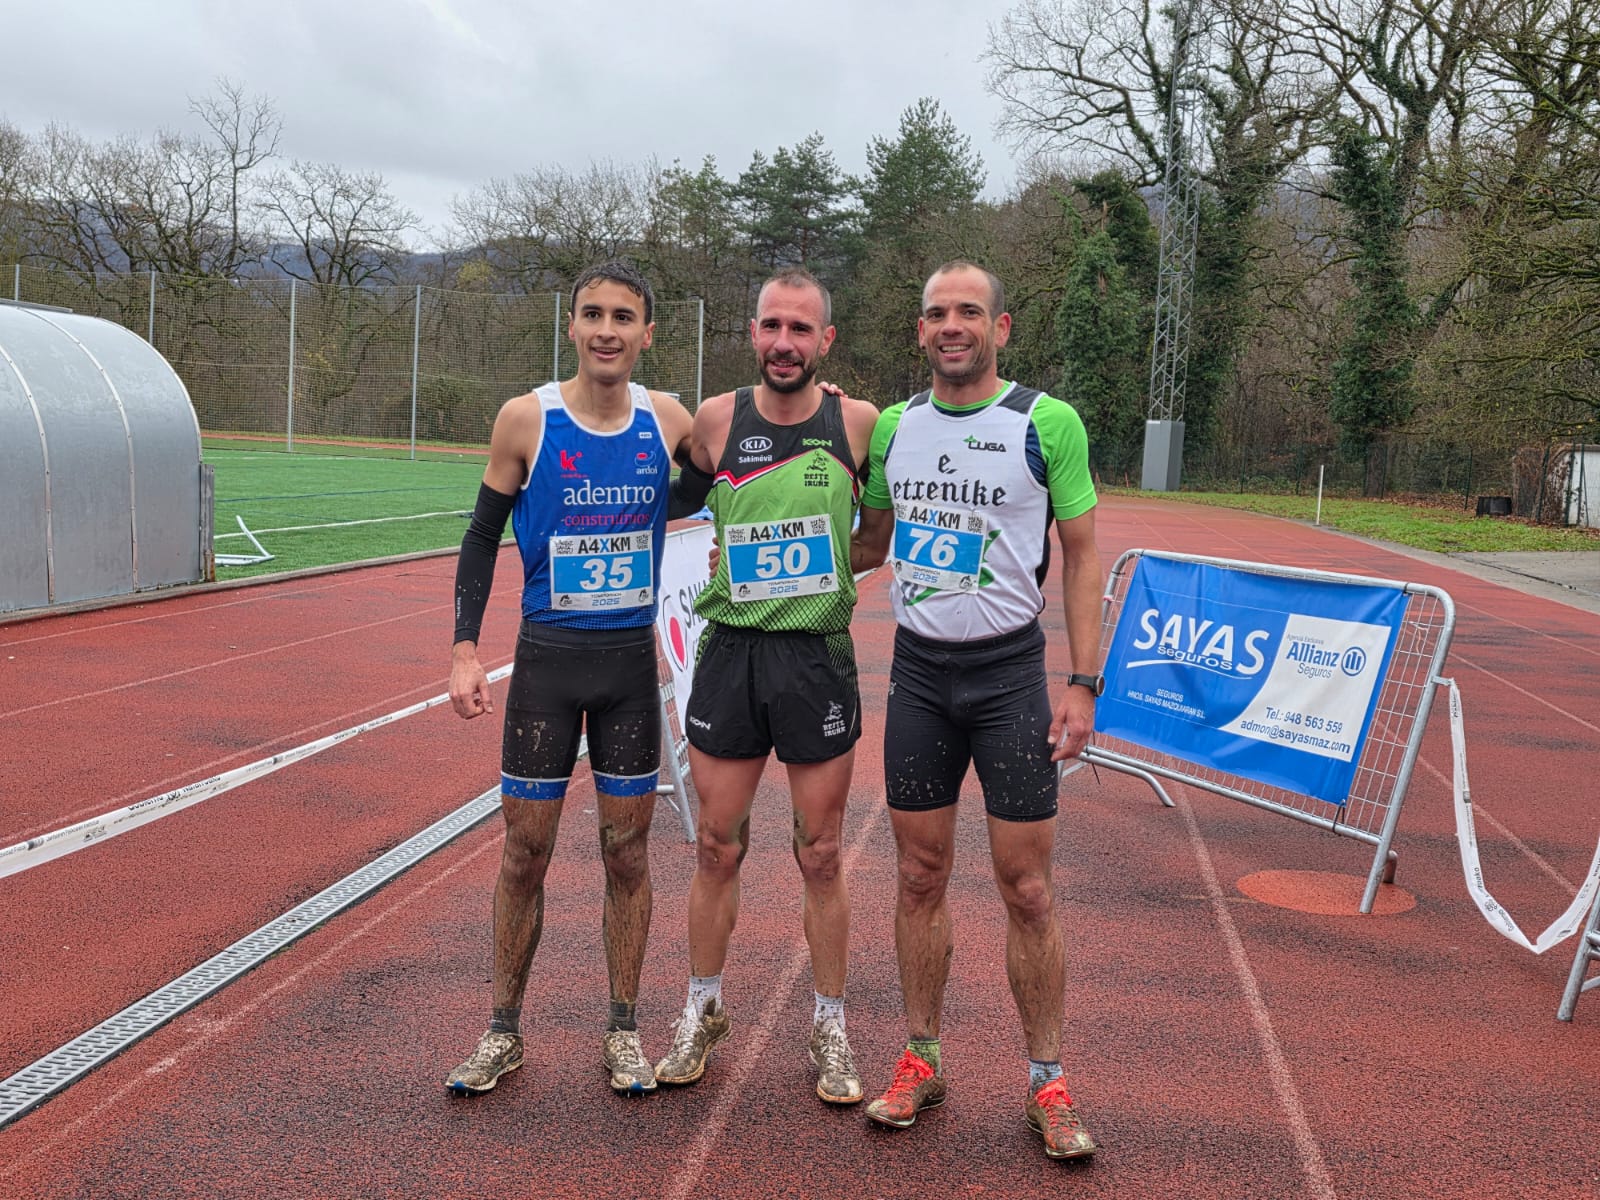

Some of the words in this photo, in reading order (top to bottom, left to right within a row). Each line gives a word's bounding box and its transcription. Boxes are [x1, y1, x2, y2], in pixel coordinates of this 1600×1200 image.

[745, 440, 767, 450] KIA
[563, 480, 655, 506] adentro
[909, 506, 961, 530] A4XKM
[750, 521, 805, 542] A4XKM
[578, 536, 631, 554] A4XKM
[908, 528, 960, 568] 76
[755, 542, 811, 579] 50
[579, 556, 634, 591] 35
[912, 571, 938, 584] 2025
[592, 597, 621, 607] 2025
[769, 585, 799, 595] 2025
[1133, 608, 1270, 675] SAYAS
[1157, 645, 1233, 671] seguros
[1286, 641, 1341, 668] Allianz
[1297, 663, 1333, 679] Seguros
[1156, 688, 1184, 703] SEGUROS
[1266, 707, 1284, 720] Tel.:
[1284, 712, 1302, 725] 948
[1305, 715, 1325, 730] 563
[1325, 720, 1343, 734] 559
[1240, 720, 1351, 754] admon@sayasmaz.com
